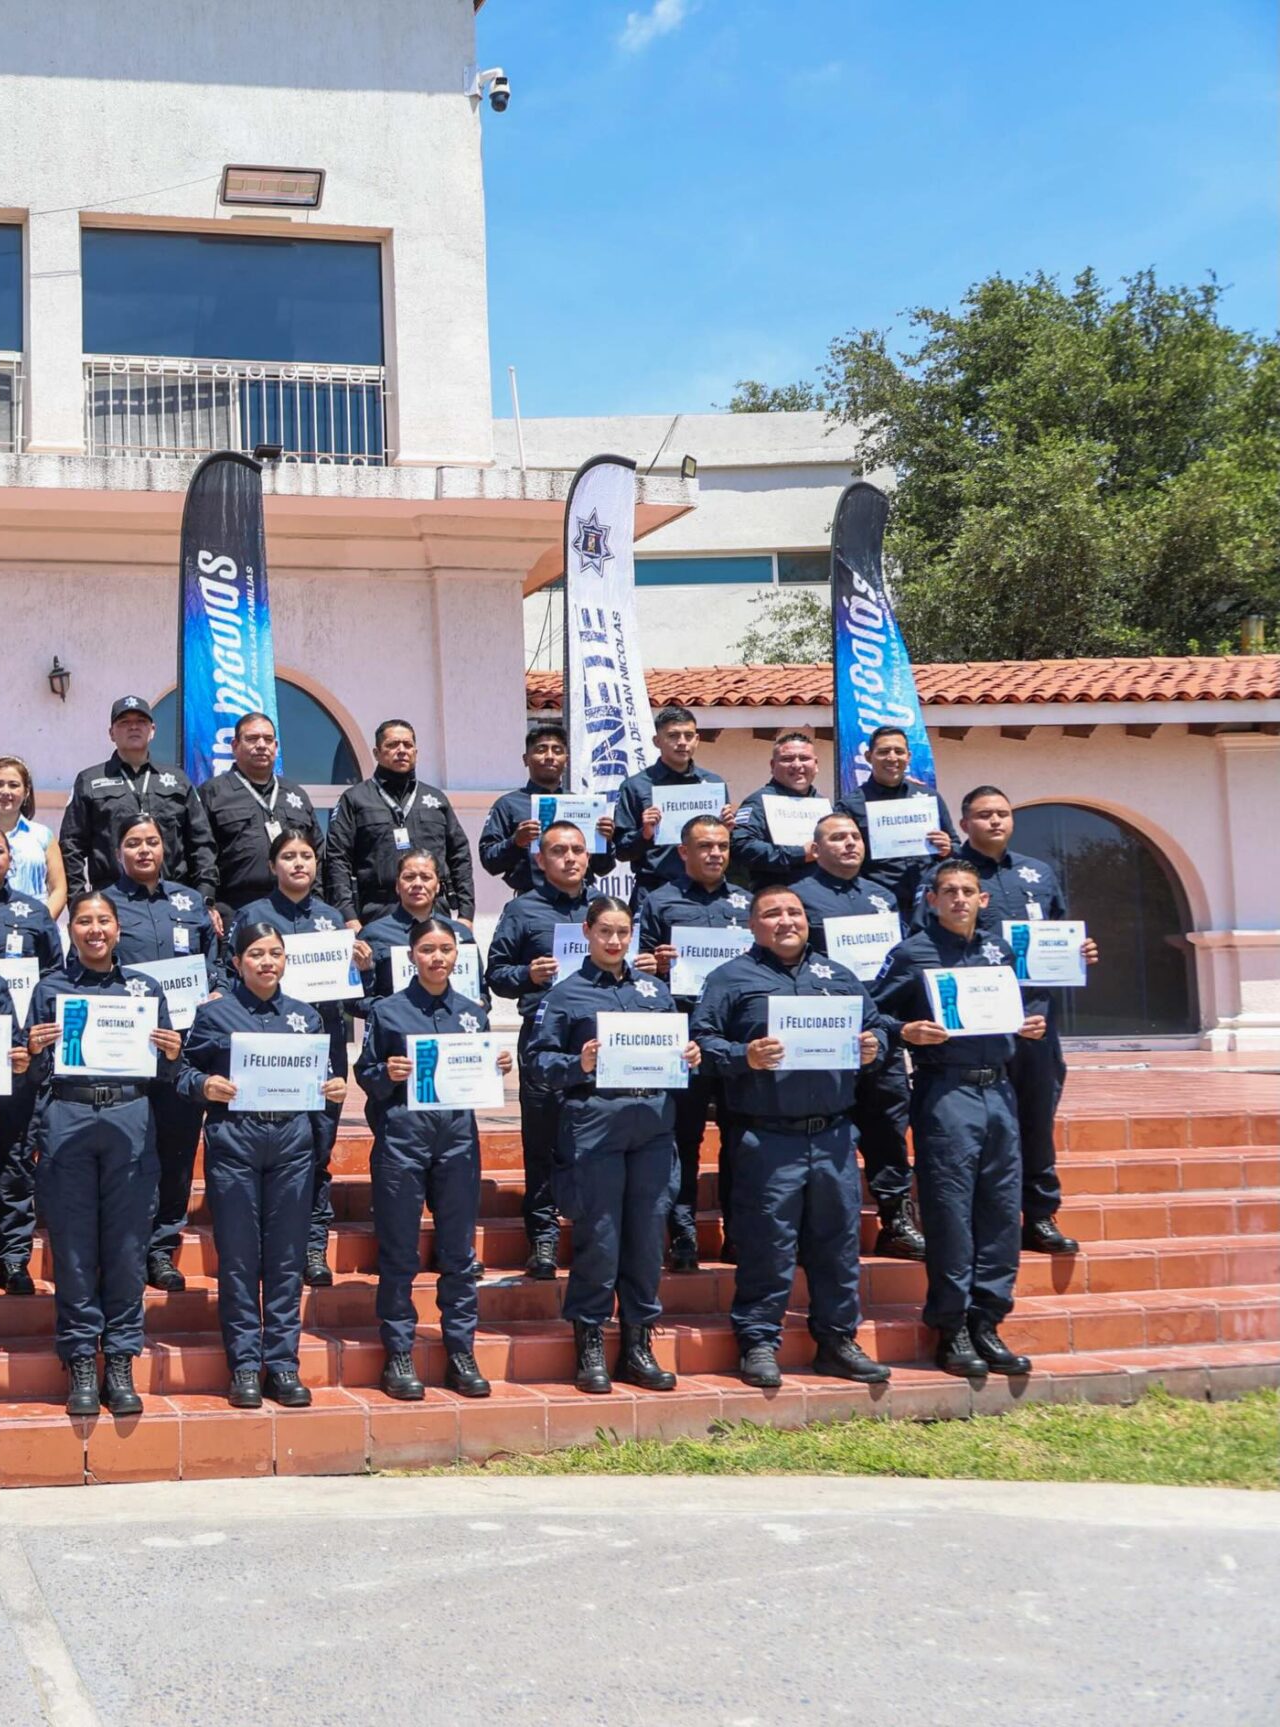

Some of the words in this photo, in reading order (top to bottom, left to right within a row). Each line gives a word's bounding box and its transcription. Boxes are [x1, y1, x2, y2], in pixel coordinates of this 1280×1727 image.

[245, 565, 257, 623] FAMILIAS
[621, 684, 637, 717] SAN
[627, 719, 642, 742] DE
[666, 799, 713, 812] FELICIDADES
[96, 1018, 135, 1029] CONSTANCIA
[786, 1015, 846, 1029] FELICIDADES
[615, 1032, 673, 1047] FELICIDADES
[250, 1053, 312, 1068] FELICIDADES
[447, 1055, 482, 1065] CONSTANCIA
